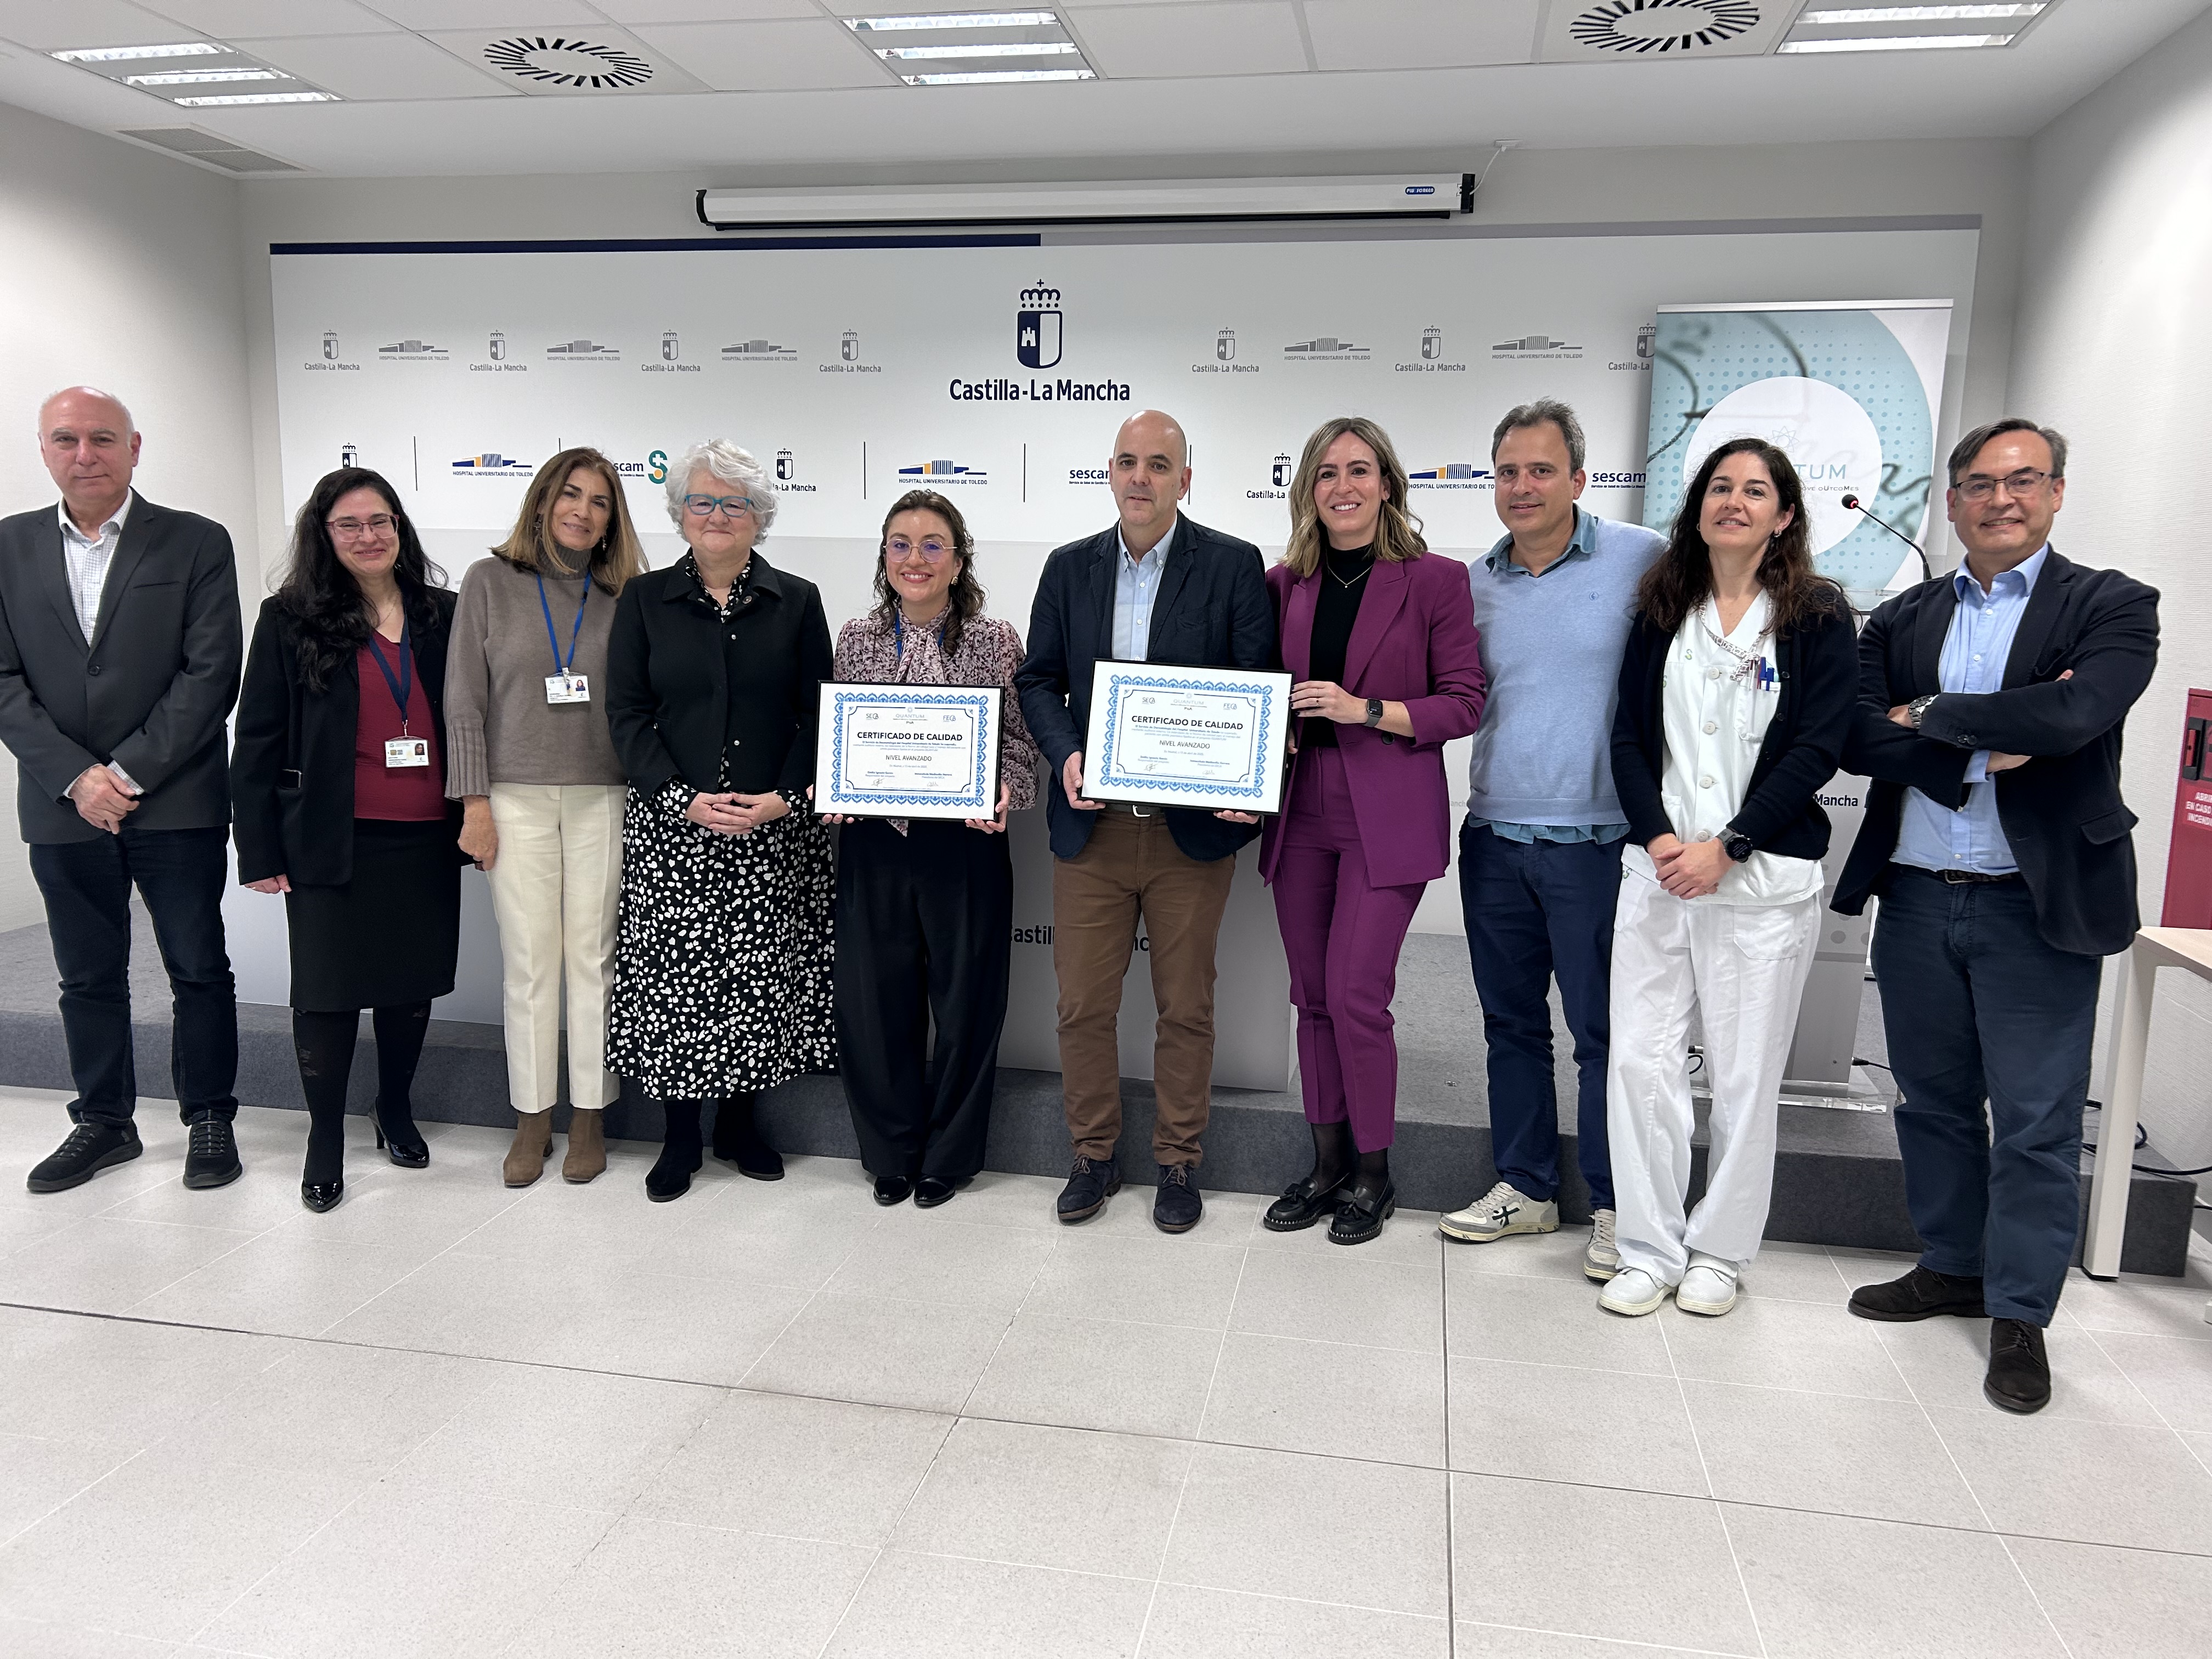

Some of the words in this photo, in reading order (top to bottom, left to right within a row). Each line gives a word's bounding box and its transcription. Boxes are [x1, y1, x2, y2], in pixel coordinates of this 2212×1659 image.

[304, 362, 336, 370] Castilla-La
[337, 363, 360, 371] Mancha
[469, 364, 502, 372] Castilla-La
[504, 364, 527, 372] Mancha
[641, 364, 675, 372] Castilla-La
[676, 364, 701, 373] Mancha
[819, 364, 854, 373] Castilla-La
[856, 364, 882, 373] Mancha
[1192, 364, 1230, 373] Castilla-La
[1232, 364, 1260, 373] Mancha
[1395, 363, 1435, 372] Castilla-La
[1437, 363, 1466, 371] Mancha
[1608, 362, 1650, 370] Castilla-La
[1057, 379, 1130, 401] Mancha
[1592, 472, 1646, 482] sescam
[1246, 490, 1285, 499] Castilla-La
[1131, 715, 1189, 726] CERTIFICADO
[1205, 721, 1243, 730] CALIDAD
[857, 731, 911, 740] CERTIFICADO
[1814, 794, 1858, 806] Mancha
[2187, 812, 2212, 827] INCENDI
